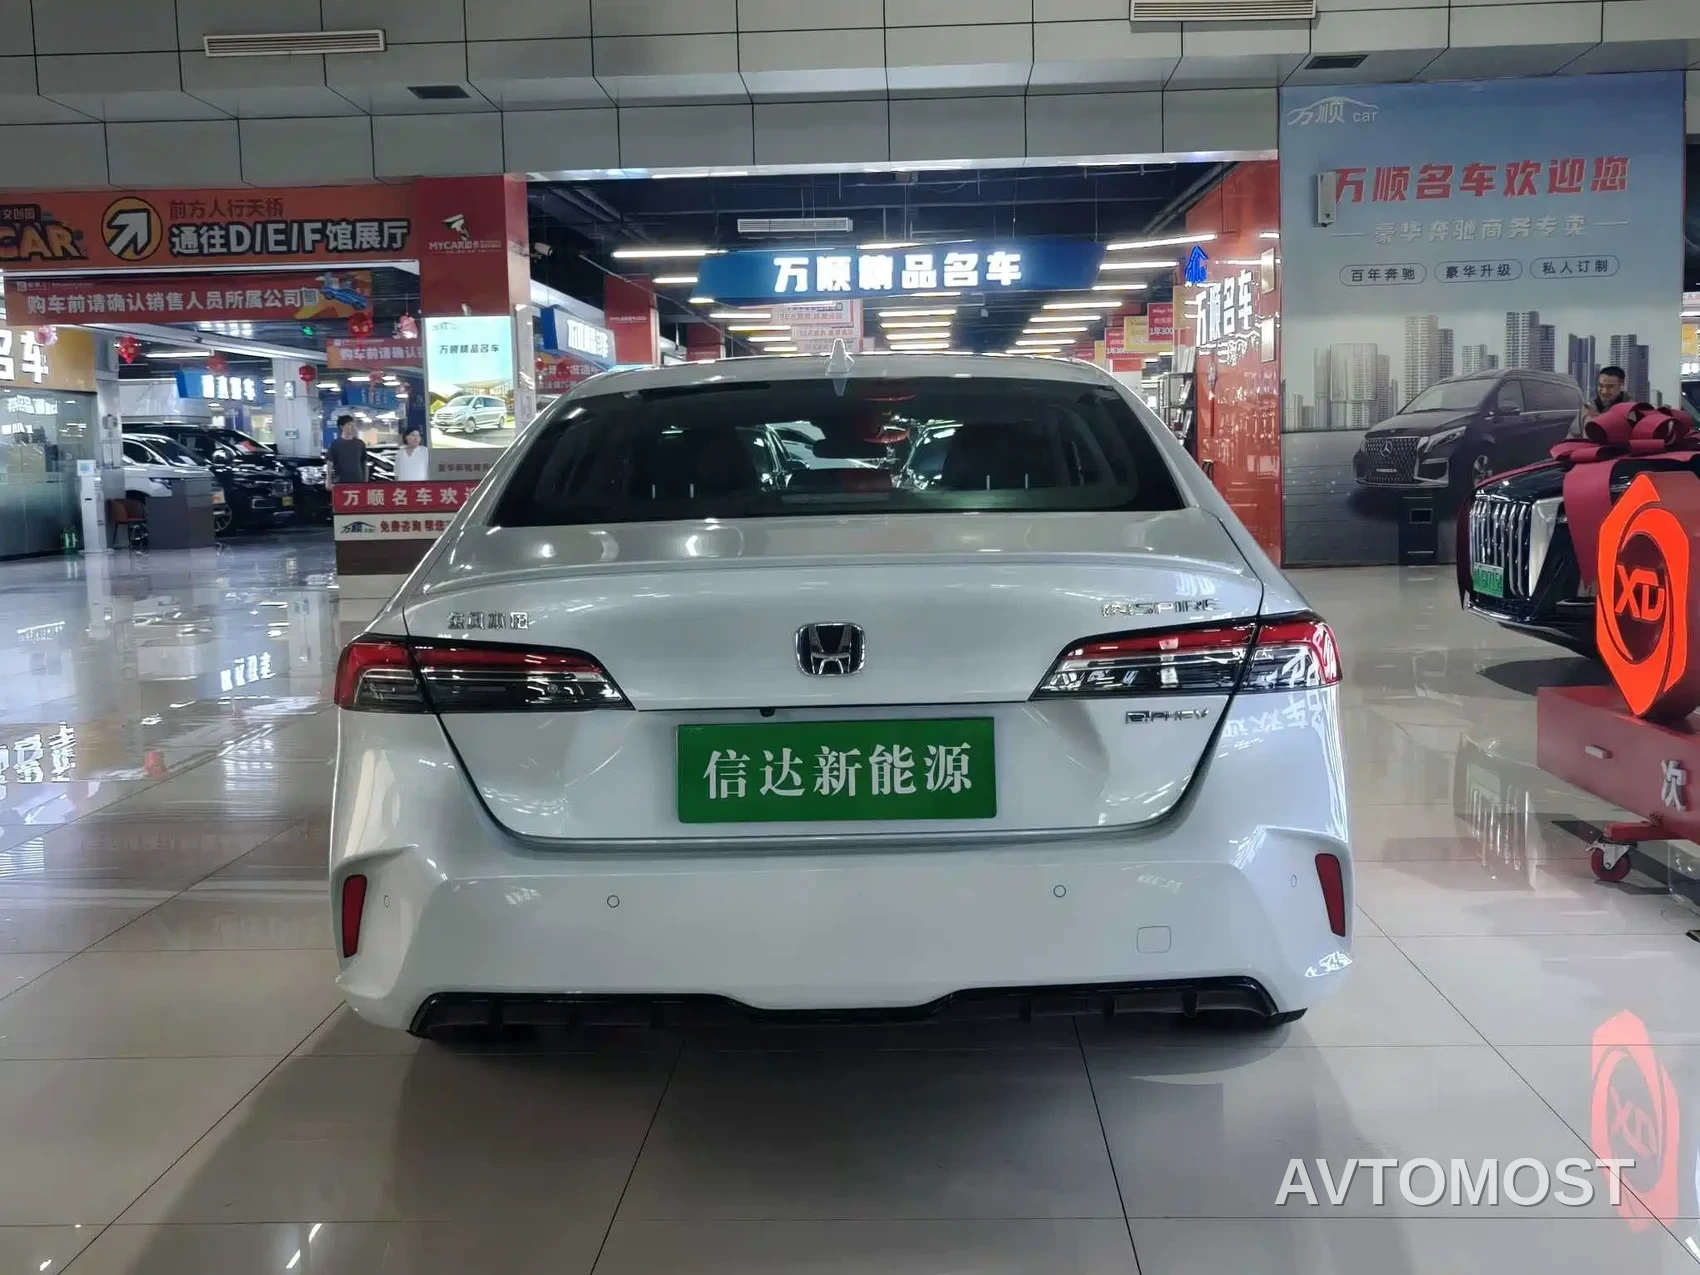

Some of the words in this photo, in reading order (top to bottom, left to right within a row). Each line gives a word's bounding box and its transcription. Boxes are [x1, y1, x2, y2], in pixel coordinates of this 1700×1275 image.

[1352, 110, 1378, 123] car
[1336, 156, 1629, 204] 万顺名车欢迎您
[169, 198, 284, 220] 前方人行天桥
[1373, 214, 1589, 246] 豪华奔驰商务专卖
[773, 251, 1022, 292] 万顺精品名车
[1350, 269, 1416, 282] 百年奔驰
[1445, 263, 1511, 279] 豪华升级
[1542, 258, 1608, 275] 私人订制
[27, 288, 301, 315] 购车前请确认销售人员所属公司
[702, 742, 973, 800] 信达新能源
